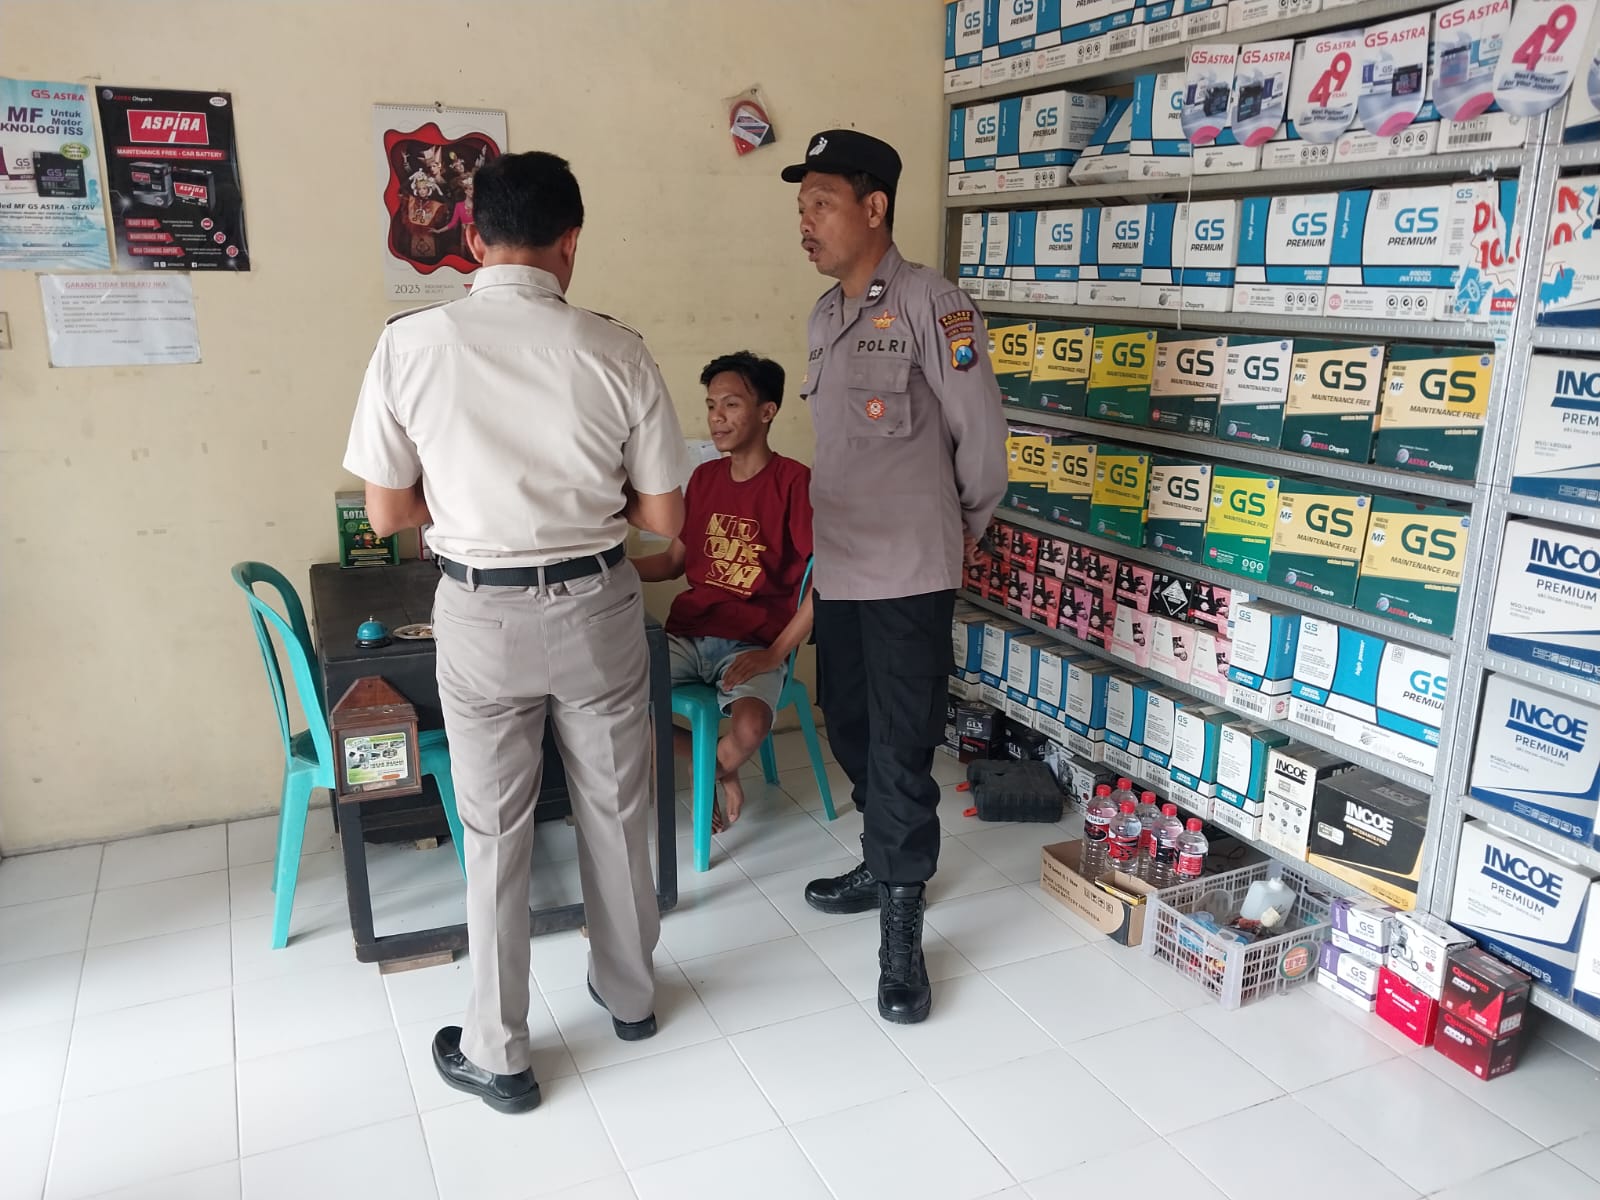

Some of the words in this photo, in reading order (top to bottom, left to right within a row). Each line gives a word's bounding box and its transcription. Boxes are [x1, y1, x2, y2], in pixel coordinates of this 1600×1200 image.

[1013, 0, 1033, 15] GS
[964, 11, 981, 29] GS
[1010, 13, 1033, 26] PREMIUM
[1440, 9, 1465, 30] GS
[1467, 1, 1509, 22] ASTRA
[963, 29, 980, 38] PREMIUM
[1364, 32, 1389, 47] GS
[1390, 26, 1425, 43] ASTRA
[1316, 42, 1331, 53] GS
[1332, 40, 1356, 50] ASTRA
[1191, 51, 1207, 64] GS
[1207, 55, 1234, 64] ASTRA
[1242, 50, 1261, 63] GS
[1262, 52, 1290, 62] ASTRA
[1529, 75, 1554, 83] Partner
[31, 90, 50, 99] GS
[54, 93, 85, 101] ASTRA
[1072, 96, 1084, 104] GS
[8, 106, 43, 123] MF
[51, 109, 81, 118] Untuk
[1036, 107, 1058, 128] GS
[52, 118, 82, 126] Motor
[977, 116, 996, 135] GS
[64, 127, 83, 135] ISS
[1033, 128, 1057, 138] PREMIUM
[975, 135, 996, 145] PREMIUM
[16, 158, 30, 167] GS
[1456, 189, 1473, 199] GS
[1292, 212, 1327, 236] GS
[1395, 207, 1439, 233] GS
[1052, 224, 1073, 242] GS
[1115, 220, 1140, 240] GS
[1195, 219, 1224, 240] GS
[1112, 241, 1139, 249] PREMIUM
[1286, 239, 1325, 247] PREMIUM
[1387, 237, 1436, 246] PREMIUM
[65, 281, 96, 289] GARANSI
[394, 284, 421, 294] 2025
[857, 339, 906, 353] POLRI
[1002, 333, 1027, 356] GS
[1053, 338, 1083, 362] GS
[1112, 342, 1145, 368] GS
[1177, 348, 1214, 376] GS
[1106, 371, 1137, 379] MAINTENANCE
[1244, 356, 1279, 381] GS
[1320, 359, 1367, 391] GS
[1171, 378, 1205, 388] MAINTENANCE
[1294, 374, 1306, 382] MF
[1238, 383, 1270, 392] MAINTENANCE
[1390, 382, 1404, 391] MF
[1420, 368, 1476, 404] GS
[1312, 394, 1354, 404] MAINTENANCE
[1410, 405, 1461, 417] MAINTENANCE
[1022, 446, 1045, 466] GS
[1063, 455, 1087, 477] GS
[1110, 464, 1137, 488] GS
[1168, 476, 1199, 501] GS
[1162, 501, 1191, 510] MAINTENANCE
[1230, 489, 1265, 517] GS
[1224, 514, 1256, 525] MAINTENANCE
[1280, 511, 1292, 520] MF
[1306, 503, 1354, 538] GS
[1297, 534, 1341, 549] MAINTENANCE
[1342, 544, 1357, 553] FREE
[1371, 532, 1385, 542] MF
[1401, 523, 1457, 561] GS
[1391, 556, 1440, 574] MAINTENANCE
[1441, 566, 1460, 578] FREE
[1536, 579, 1597, 602] PREMIUM
[1239, 610, 1251, 619] GS
[1305, 622, 1318, 632] GS
[1355, 664, 1363, 676] high
[1410, 670, 1449, 700] GS
[1178, 715, 1188, 724] GS
[1510, 698, 1588, 743] INCOE
[1223, 730, 1234, 740] GS
[1515, 735, 1569, 761] PREMIUM
[1276, 758, 1308, 779] INCOE
[1346, 800, 1394, 834] INCOE
[1484, 844, 1563, 898] INCOE
[1491, 882, 1545, 915] PREMIUM
[1359, 921, 1375, 934] GS
[1423, 945, 1437, 960] GS
[1351, 966, 1367, 981] GS
